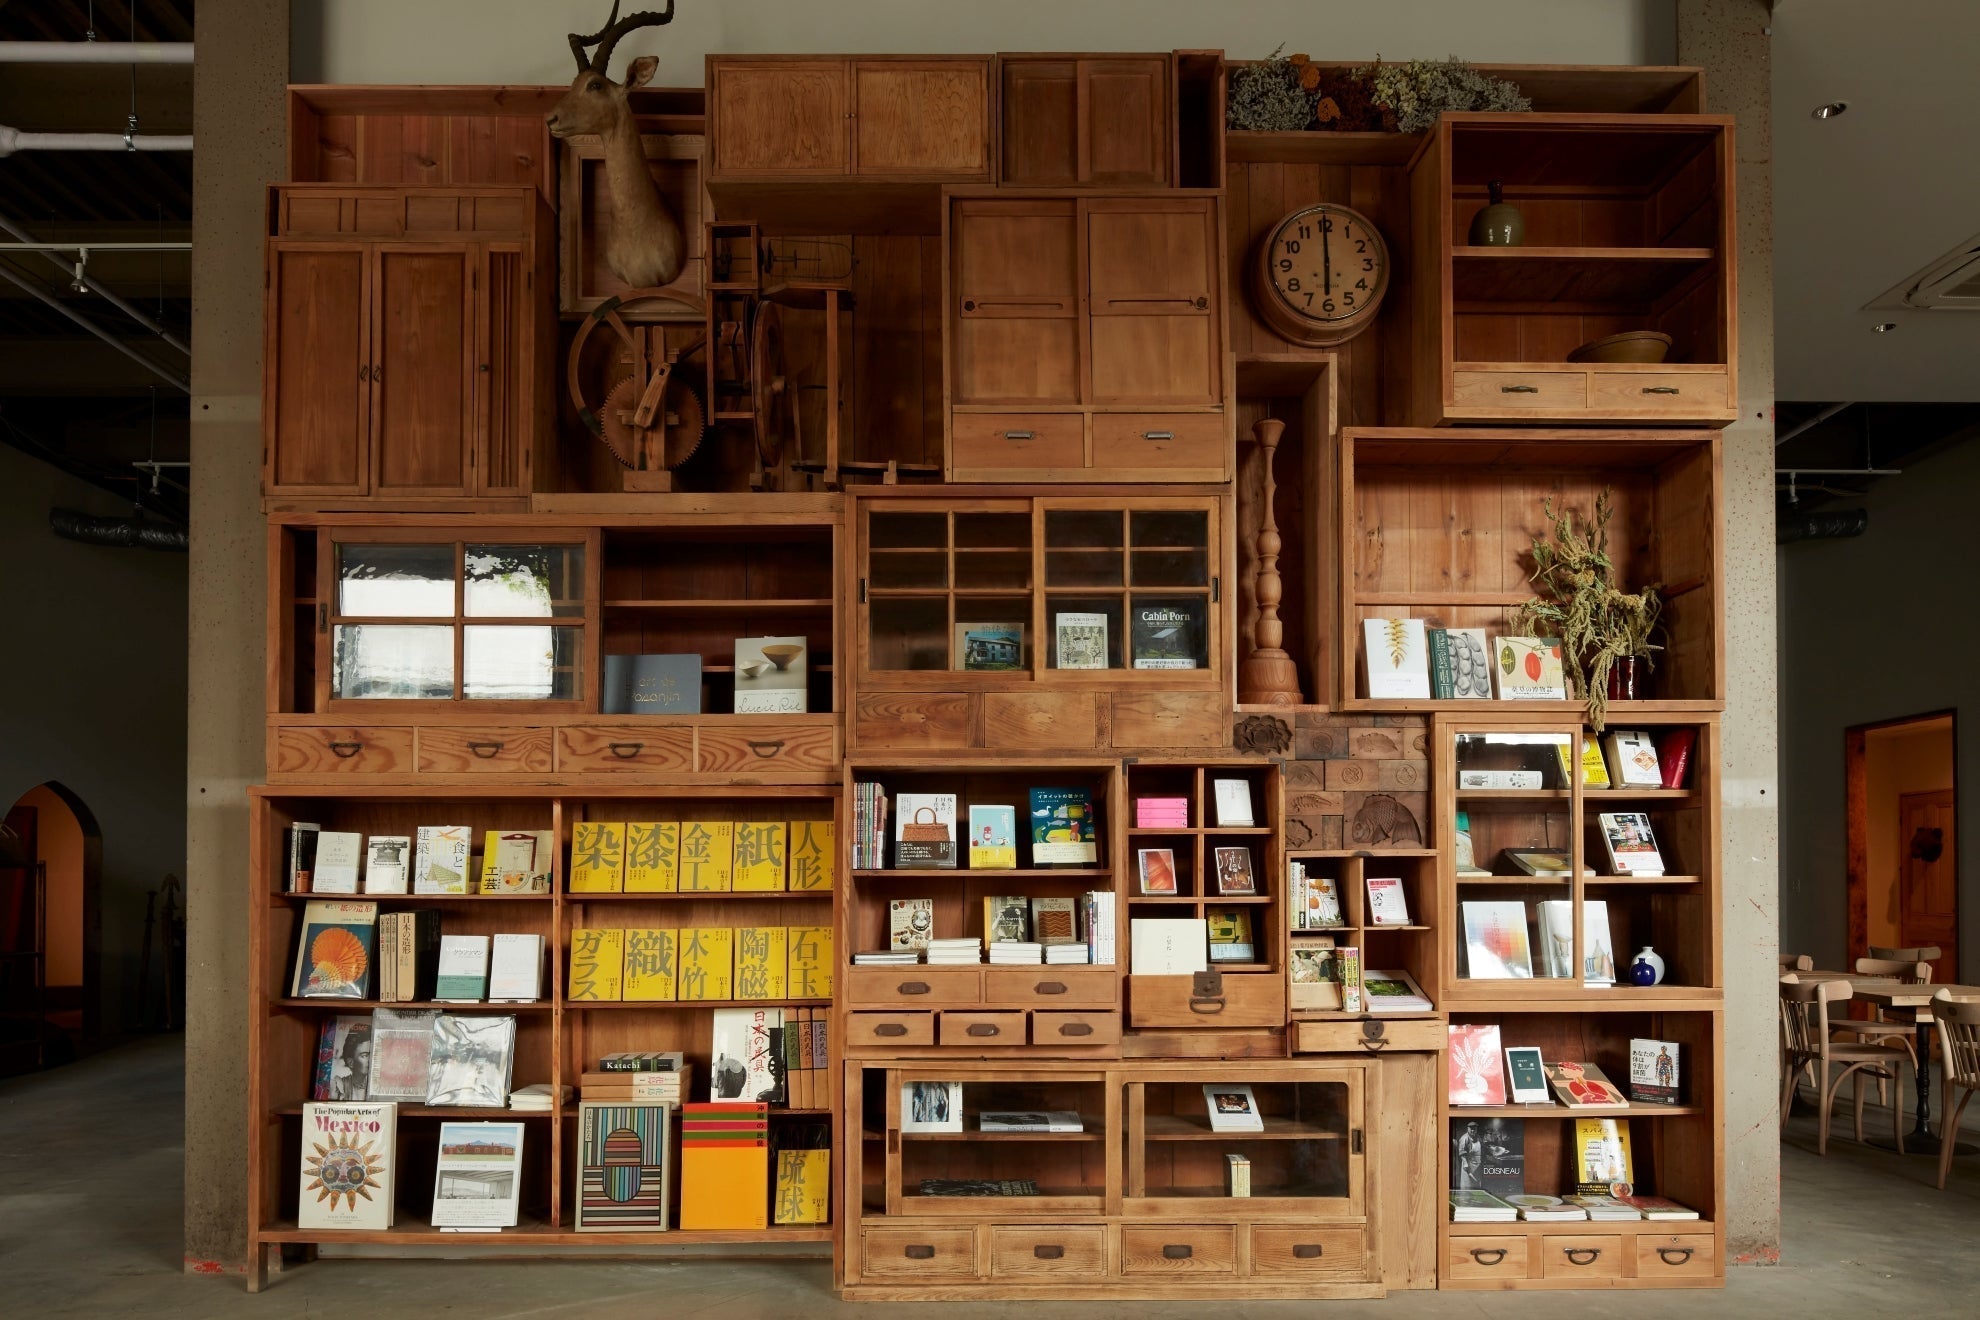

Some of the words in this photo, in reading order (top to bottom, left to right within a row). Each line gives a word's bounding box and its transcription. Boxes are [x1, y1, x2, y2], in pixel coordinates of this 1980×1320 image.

[1298, 225, 1310, 239] 11
[1344, 225, 1350, 239] 1
[1285, 240, 1300, 254] 10
[1354, 240, 1366, 253] 2
[1279, 259, 1292, 272] 9
[1362, 258, 1373, 272] 3
[1287, 278, 1300, 292] 8
[1355, 278, 1368, 291] 4
[1303, 292, 1314, 306] 7
[1322, 298, 1335, 312] 6
[1343, 292, 1354, 306] 5
[1141, 611, 1168, 621] Cabin
[1169, 611, 1191, 621] Porn
[573, 824, 621, 870] 染
[628, 823, 676, 870] 漆
[735, 822, 783, 868] 紙
[681, 823, 712, 891] 金工
[793, 822, 822, 889] 人形
[626, 930, 674, 978] 織
[570, 929, 607, 1000] ガラス
[738, 928, 770, 999] 陶磁
[750, 1010, 767, 1073] 日本の民具
[1632, 1050, 1656, 1058] あなたの
[606, 1061, 641, 1069] Katachi
[314, 1107, 328, 1115] The
[328, 1107, 356, 1117] Popular
[372, 1107, 382, 1116] of
[315, 1115, 381, 1133] Mexico
[1483, 1167, 1521, 1175] DOISNEAU
[776, 1150, 806, 1222] 琉球
